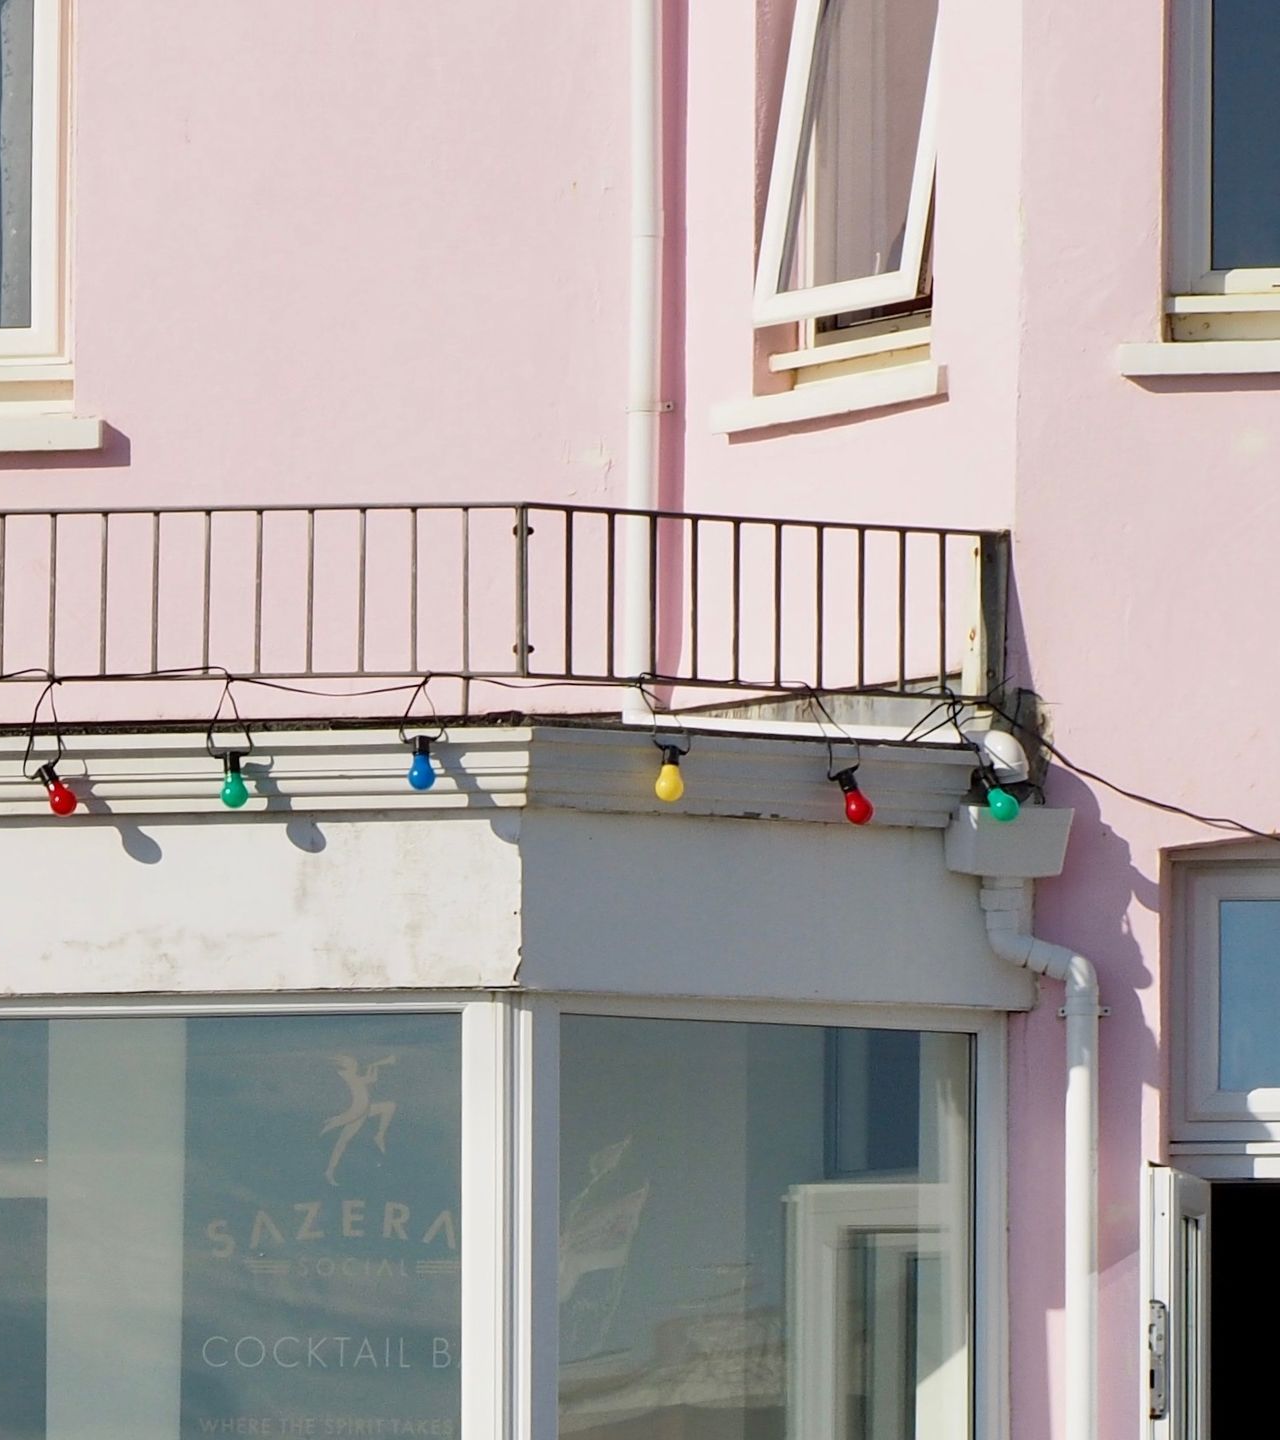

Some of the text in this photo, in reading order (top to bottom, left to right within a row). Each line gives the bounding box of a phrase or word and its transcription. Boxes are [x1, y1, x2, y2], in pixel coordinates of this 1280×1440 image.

[207, 1200, 458, 1258] SAZERA
[298, 1257, 409, 1278] SOCIAL
[202, 1336, 412, 1369] COCKTAIL
[199, 1417, 455, 1437] WHERE THE SPIRIT TAKES
